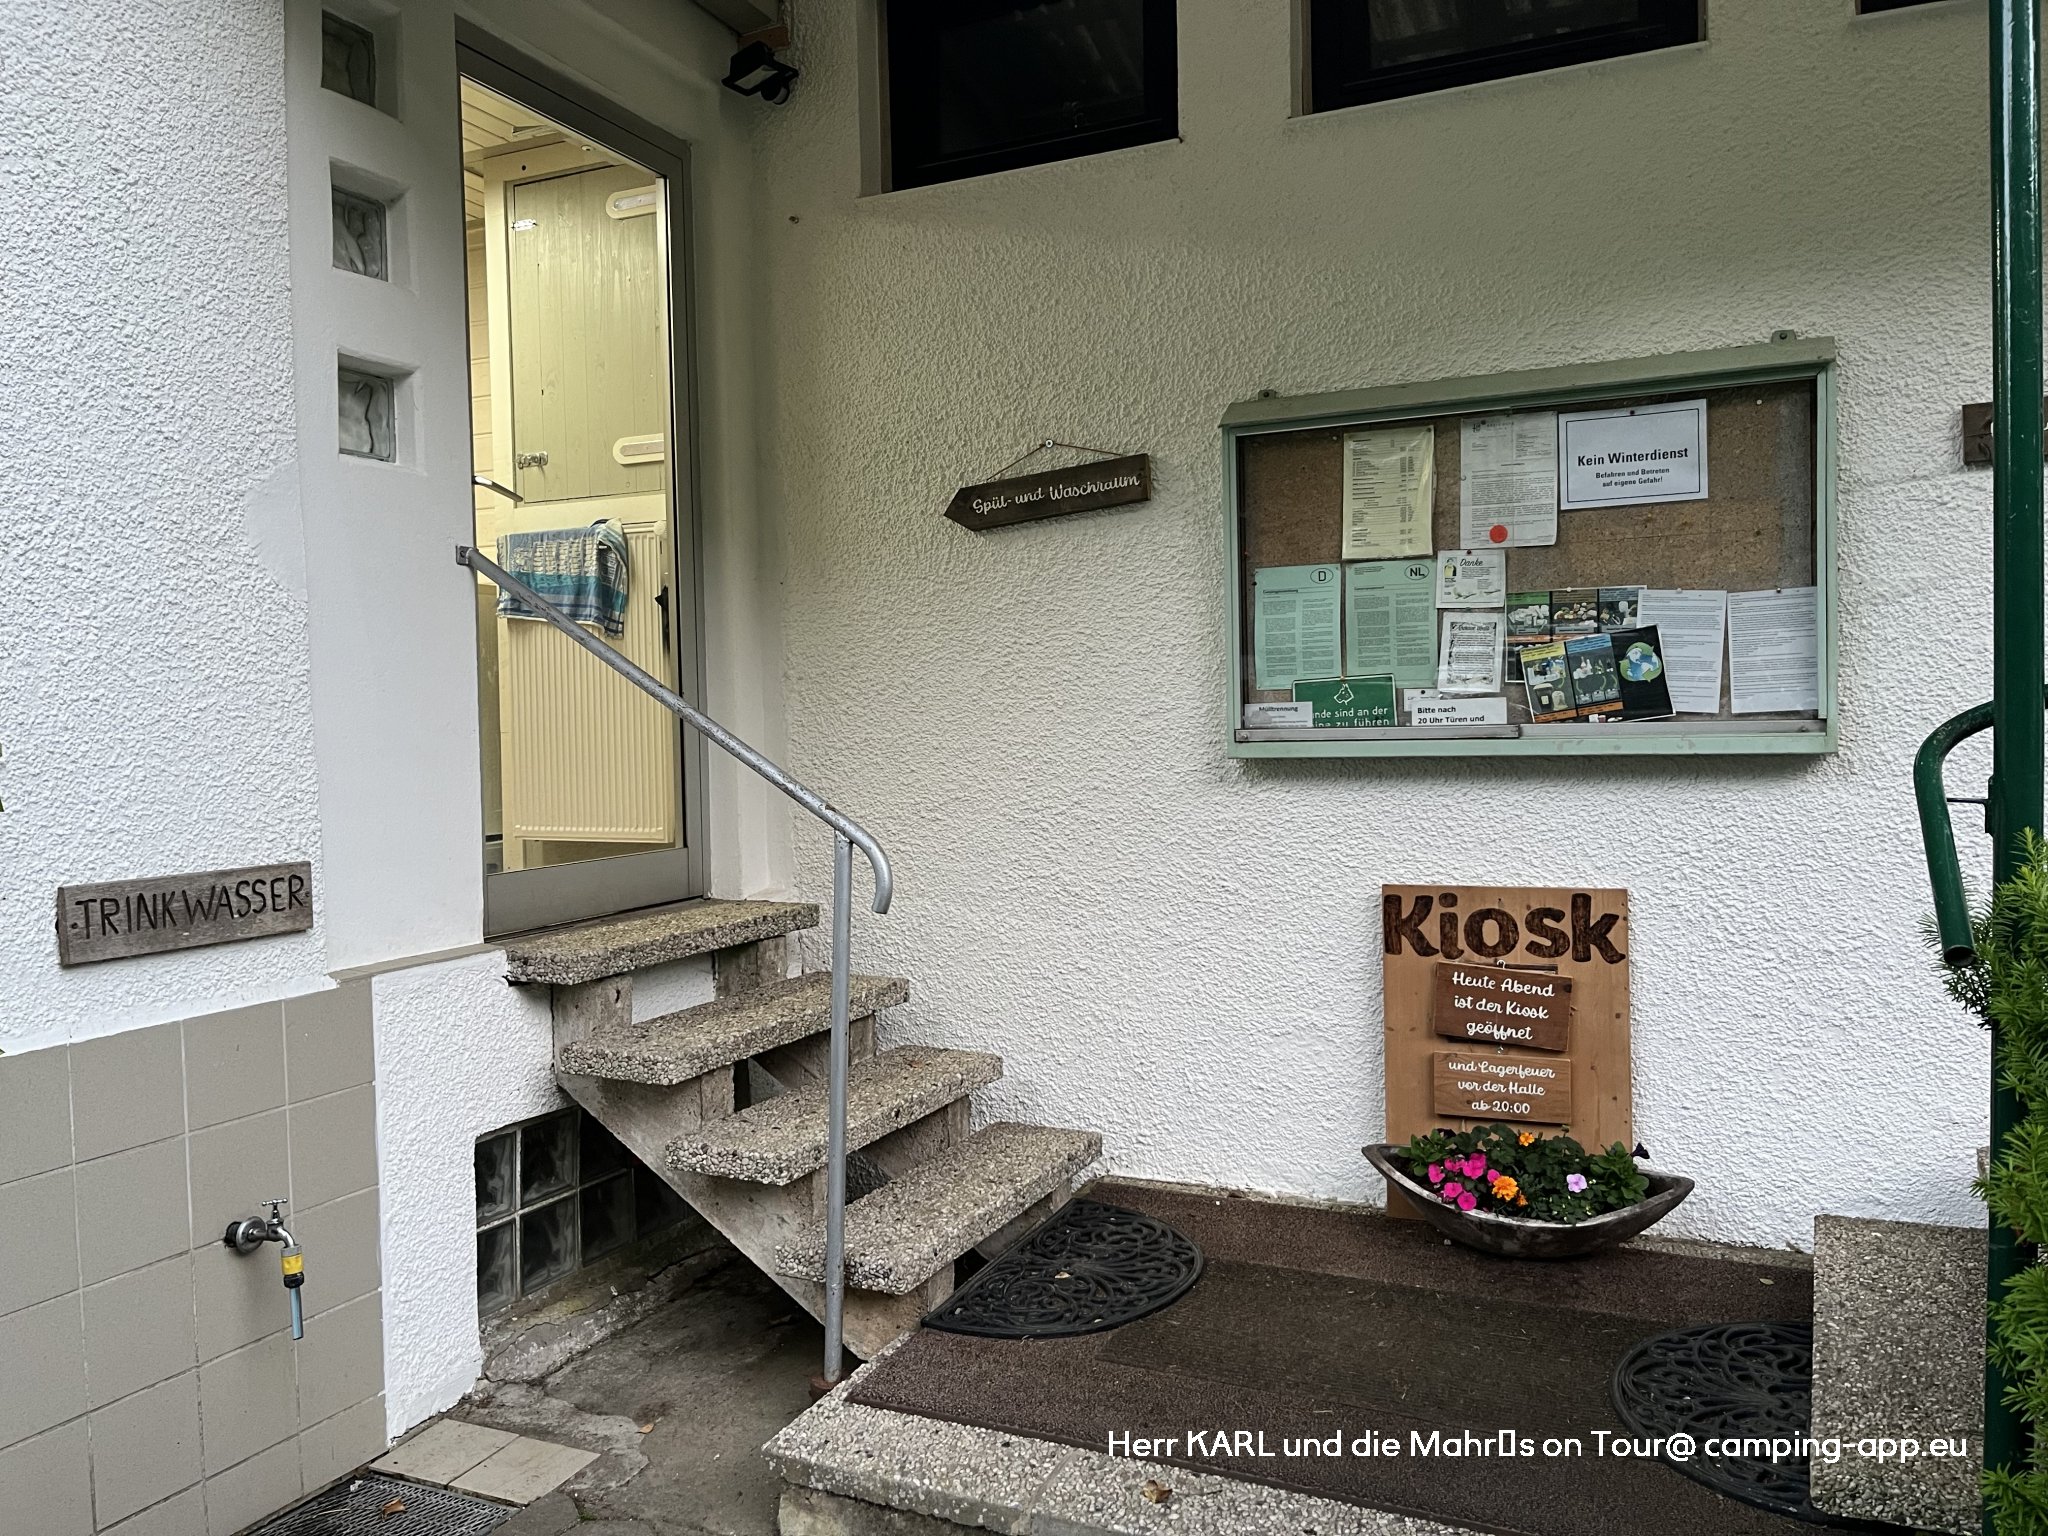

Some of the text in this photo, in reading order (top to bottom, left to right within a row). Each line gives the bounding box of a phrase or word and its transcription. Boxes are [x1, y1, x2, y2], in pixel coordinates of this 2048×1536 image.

[1577, 448, 1688, 466] Kein Winterdienst
[1595, 471, 1626, 479] Befahren
[1614, 479, 1637, 487] eigene
[1638, 476, 1663, 484] Gefahr!
[972, 474, 1140, 515] Spül- und Waschraum
[1460, 558, 1484, 567] Danke
[1318, 571, 1327, 582] D
[1409, 567, 1425, 577] NL
[1334, 707, 1354, 718] sind
[1372, 706, 1388, 715] der
[1354, 718, 1390, 727] führen
[75, 874, 305, 940] TRINKWASSER
[1383, 892, 1626, 965] Kiosk
[1452, 971, 1555, 997] Heute Abend
[1454, 995, 1549, 1020] ist der Kiosk
[1466, 1020, 1533, 1040] geöffnet
[1448, 1061, 1556, 1079] und Lagerfeuer
[1457, 1080, 1546, 1096] vor der Halle
[1471, 1100, 1531, 1114] ab 20:00
